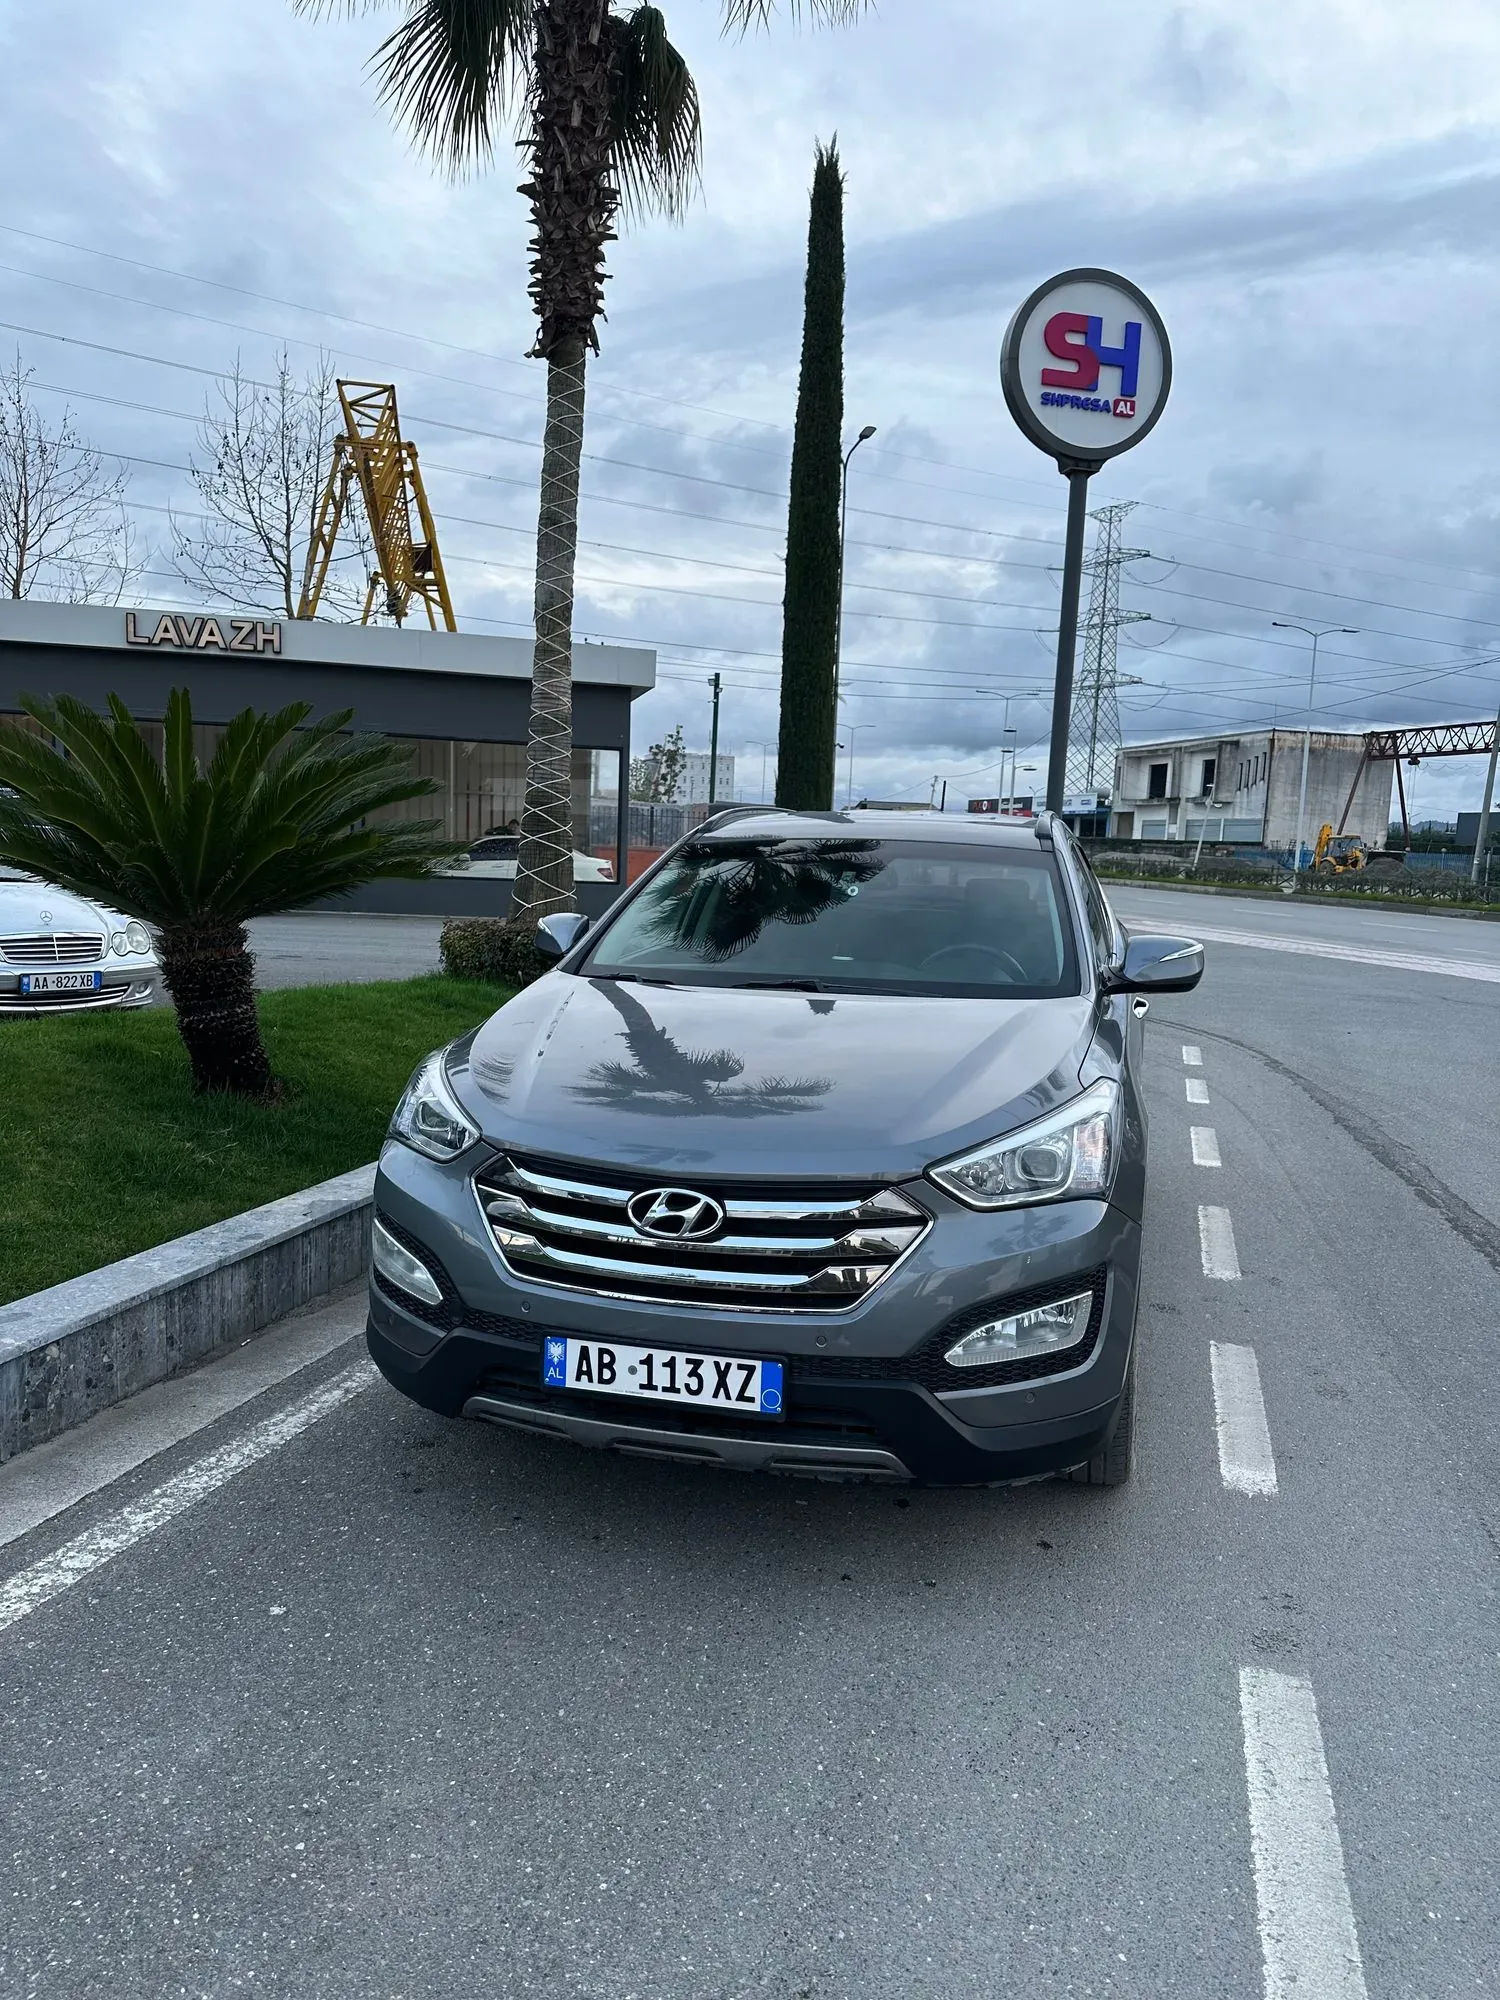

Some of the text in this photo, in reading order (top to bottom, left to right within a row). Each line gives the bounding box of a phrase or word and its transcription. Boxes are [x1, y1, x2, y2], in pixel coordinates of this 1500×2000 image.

[1041, 312, 1142, 397] SH
[1115, 401, 1134, 415] AL
[125, 612, 282, 653] LAVAZH
[547, 1368, 563, 1379] AL
